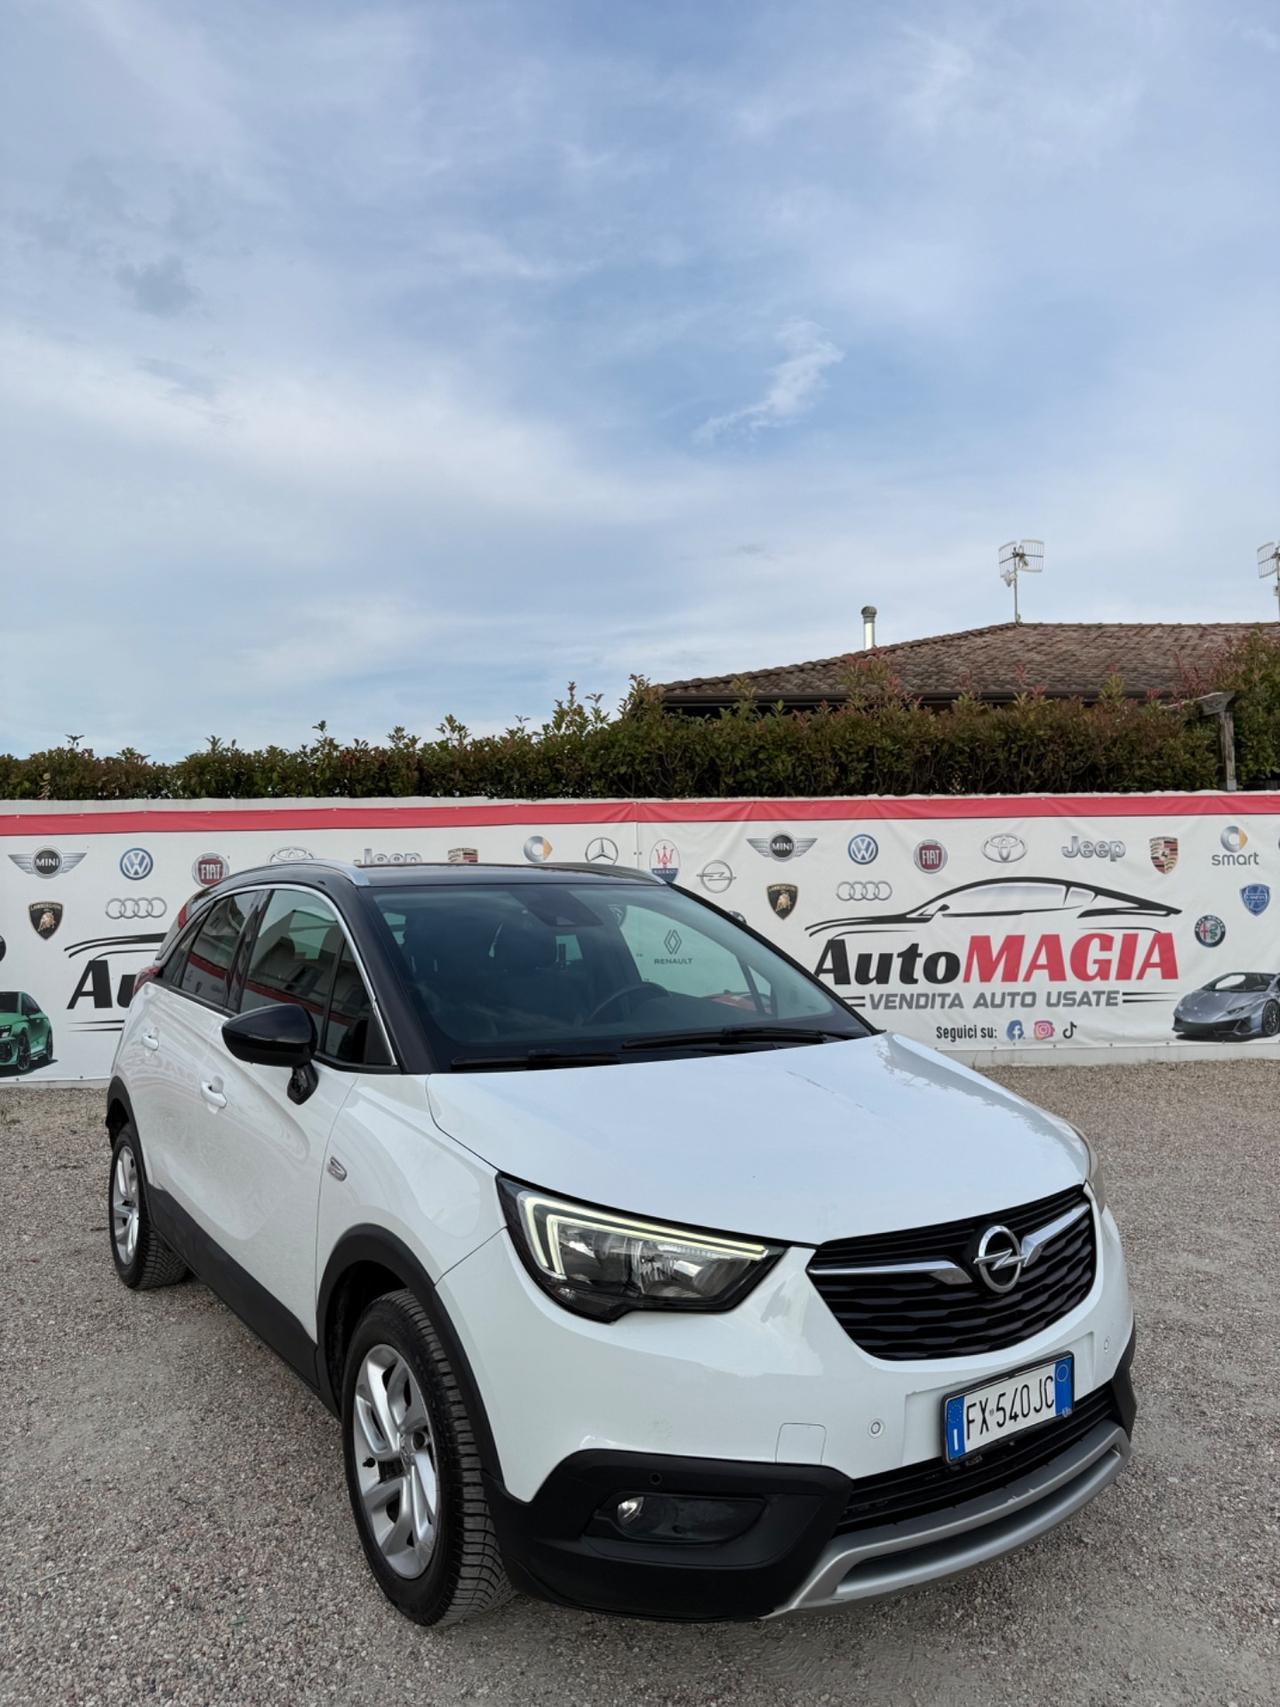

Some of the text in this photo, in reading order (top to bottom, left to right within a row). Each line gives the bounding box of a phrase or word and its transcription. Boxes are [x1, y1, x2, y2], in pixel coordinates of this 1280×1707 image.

[772, 842, 793, 851] MINI
[1061, 836, 1126, 861] Jeep
[35, 857, 59, 867] MINI
[922, 849, 941, 865] FIAT
[1211, 852, 1259, 866] smart
[201, 863, 222, 879] FIAT
[654, 957, 693, 965] RENAULT
[815, 932, 1178, 985] AutoMAGIA
[869, 990, 1120, 1010] VENDITA AUTO USATE
[936, 1025, 998, 1042] Seguici su:
